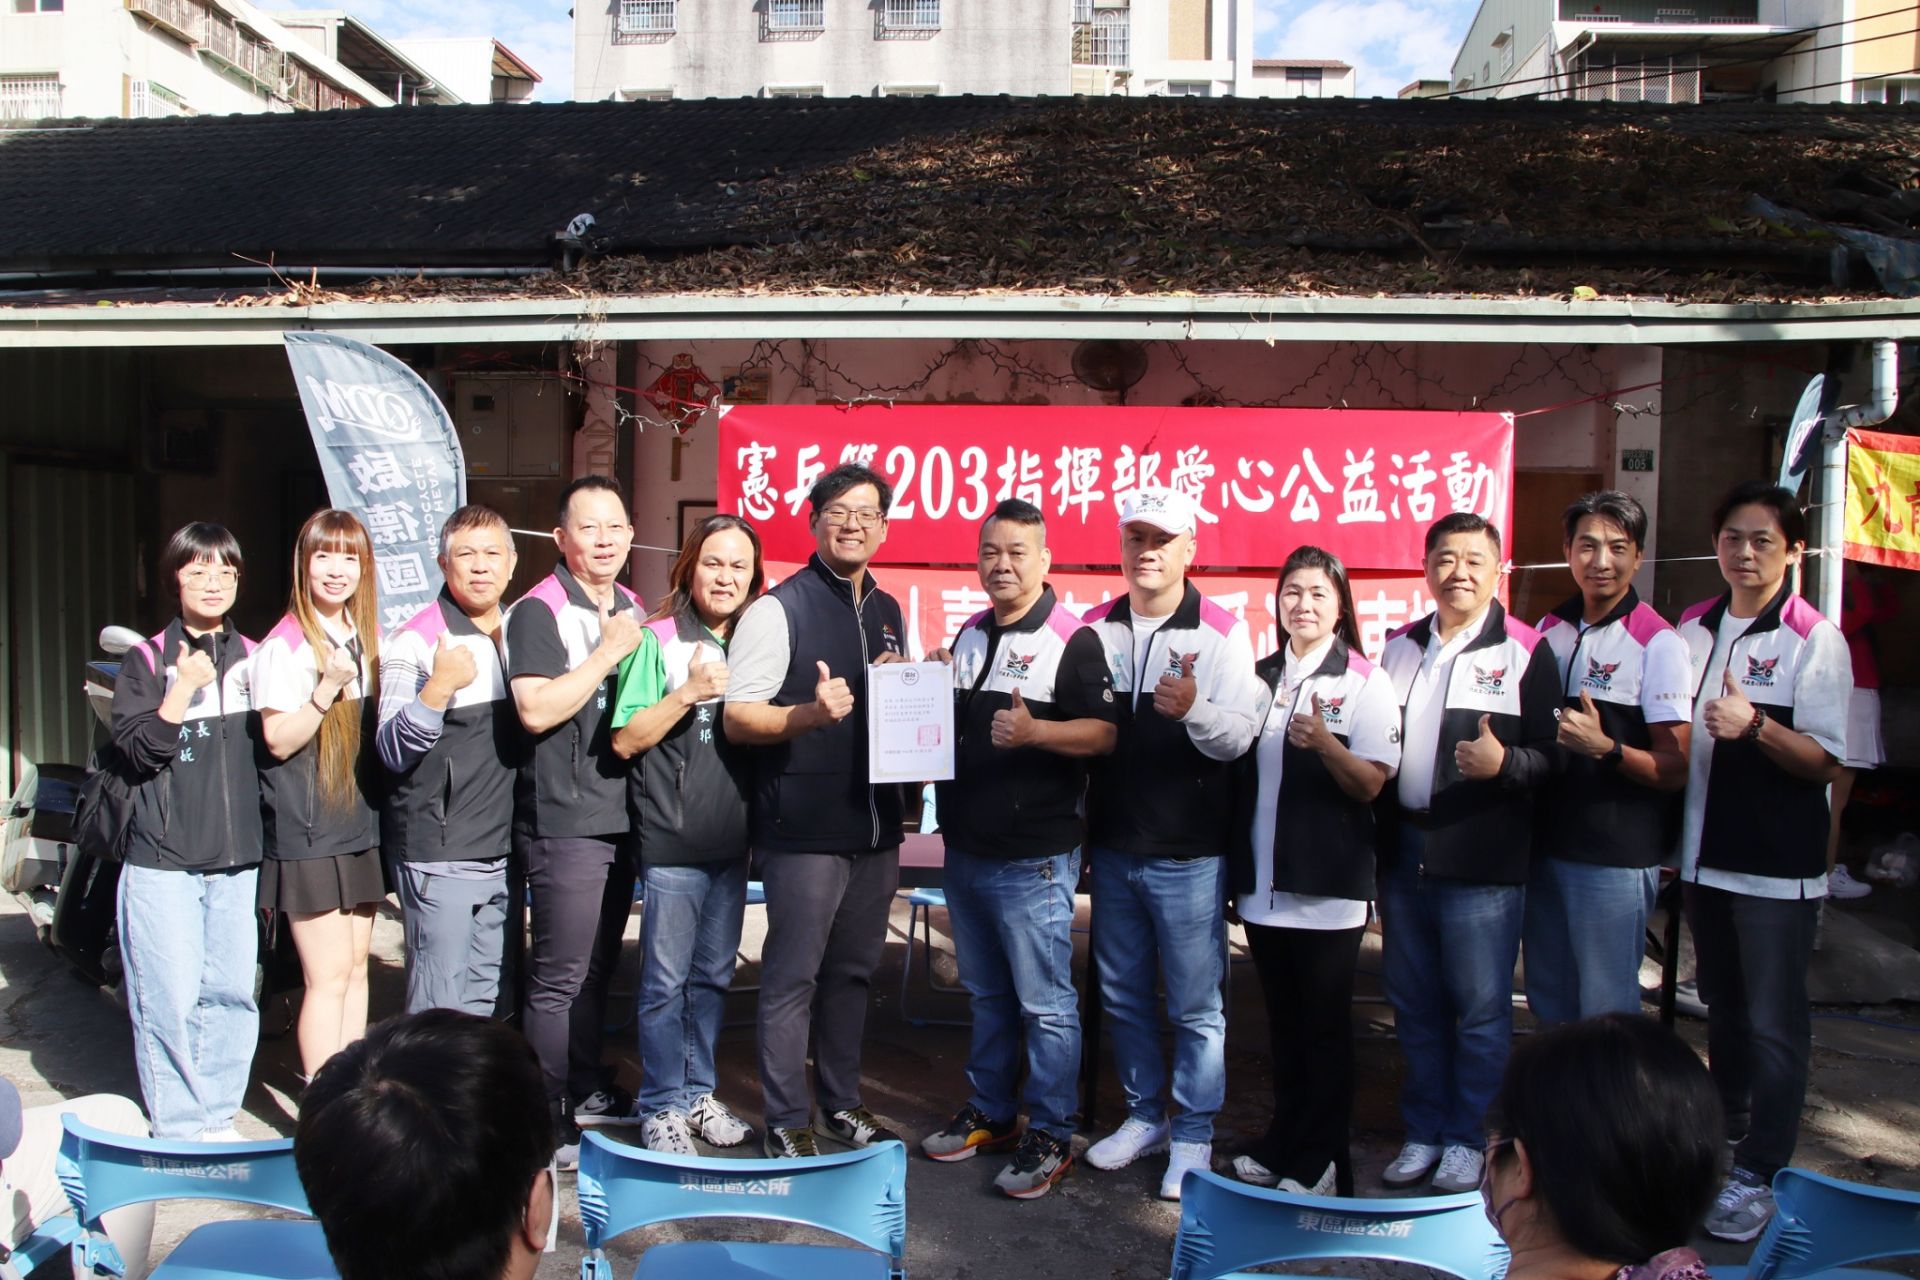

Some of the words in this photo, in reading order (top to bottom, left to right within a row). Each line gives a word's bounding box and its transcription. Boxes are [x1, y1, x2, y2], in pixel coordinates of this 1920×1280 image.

[1628, 458, 1647, 470] 005
[1861, 464, 1920, 536] 九
[140, 1155, 251, 1182] 東區區公所
[678, 1173, 792, 1196] 東區區公所
[1296, 1212, 1413, 1238] 東區區公所
